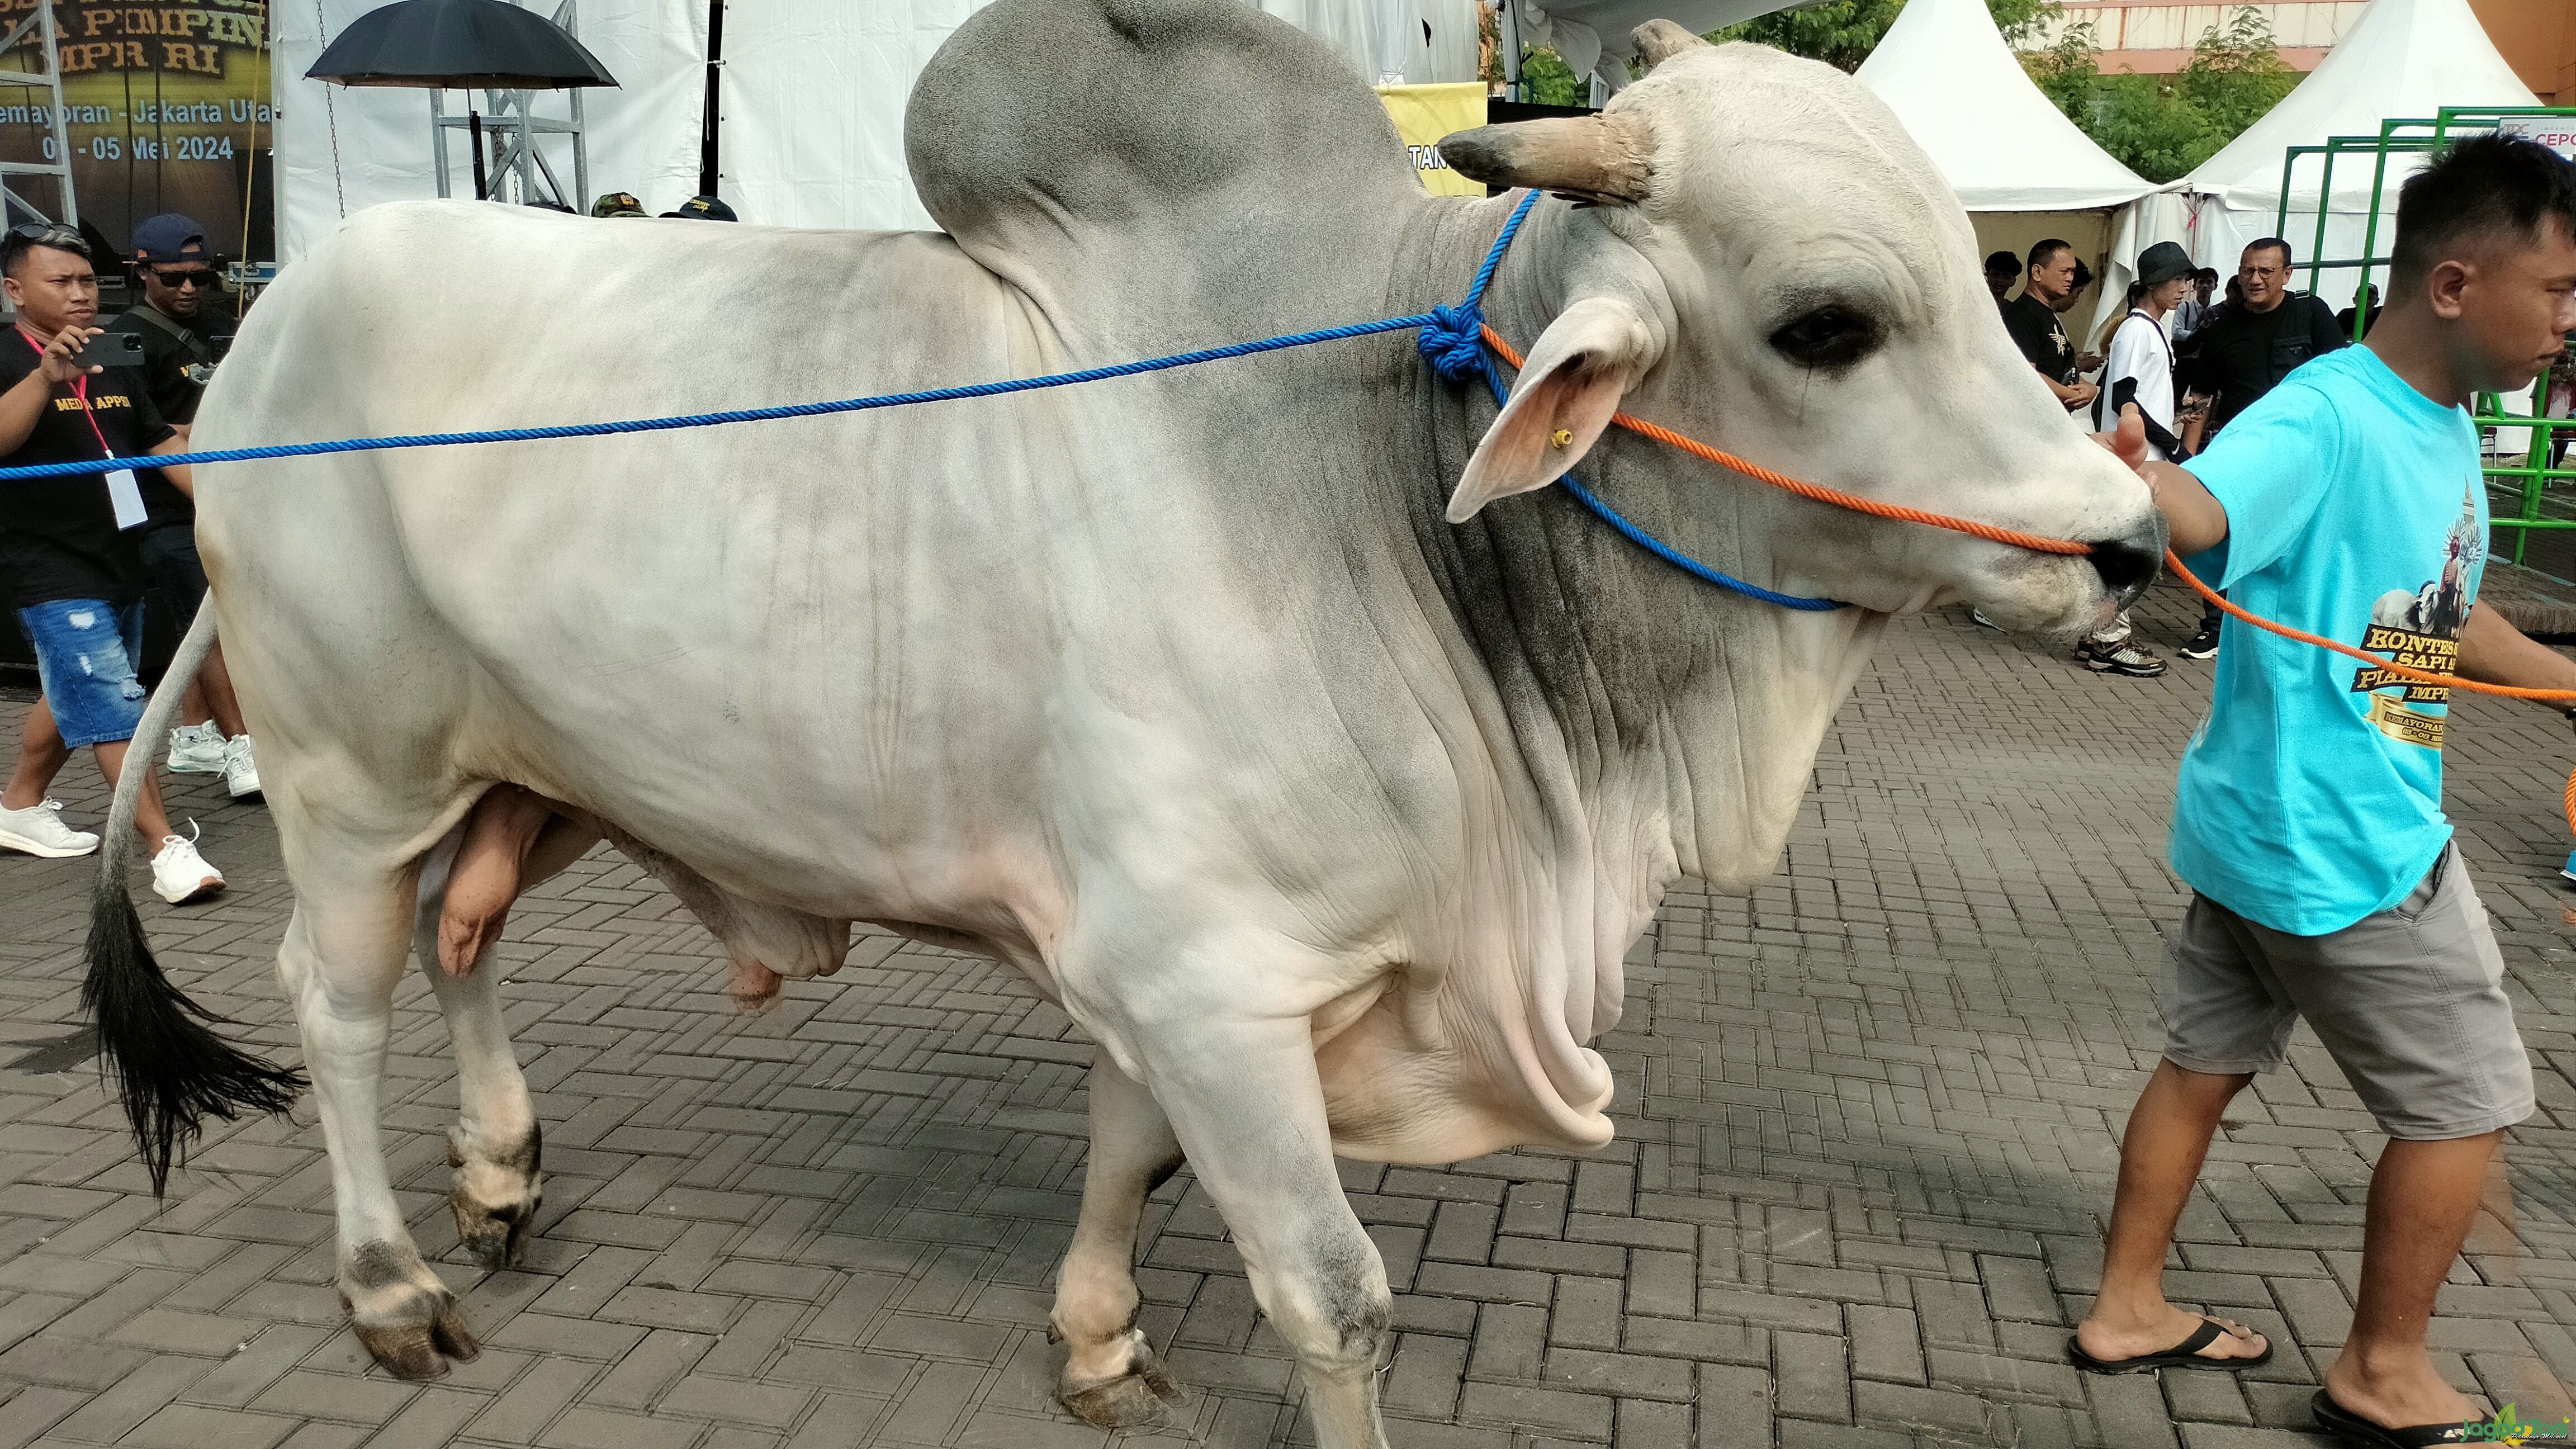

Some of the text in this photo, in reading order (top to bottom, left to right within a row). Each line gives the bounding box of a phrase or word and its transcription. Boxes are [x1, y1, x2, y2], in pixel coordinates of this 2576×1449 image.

[59, 41, 220, 74] MPR RI
[134, 100, 222, 123] Jakarta
[92, 136, 121, 160] 05
[132, 136, 169, 160] Mei
[176, 136, 234, 160] 2024
[55, 397, 94, 411] MEDA
[2366, 628, 2455, 655] KONTES
[2395, 652, 2447, 670] SAPI
[2356, 670, 2432, 688] PIA
